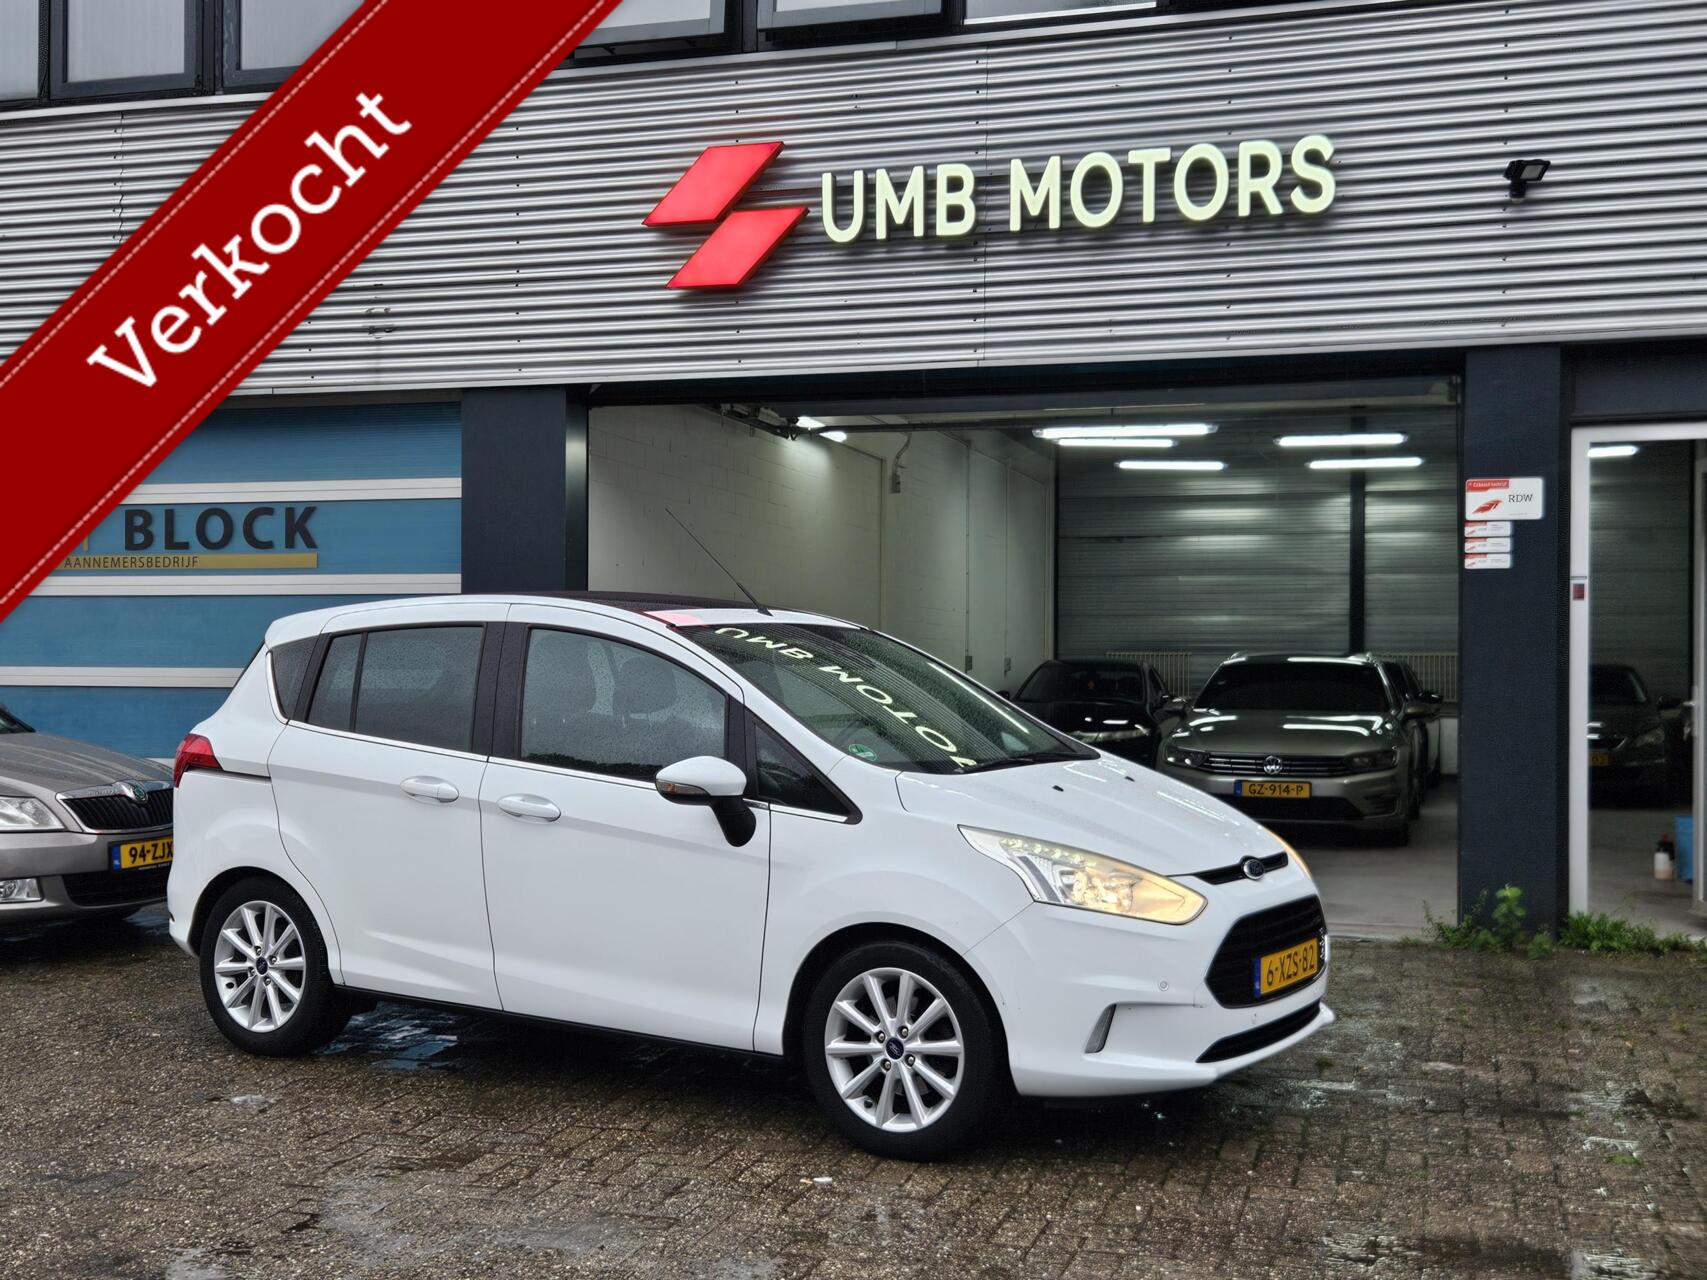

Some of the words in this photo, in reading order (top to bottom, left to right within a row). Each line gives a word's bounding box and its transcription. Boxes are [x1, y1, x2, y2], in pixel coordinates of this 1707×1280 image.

[821, 163, 977, 243] UMB
[1009, 135, 1336, 232] MOTORS
[1508, 494, 1533, 503] RDW
[125, 507, 318, 550] BLOCK
[64, 555, 199, 569] AANNEMERSBEDRIJF
[1248, 783, 1304, 796] GZ-914-P
[1266, 944, 1314, 987] 6-XZS-82
